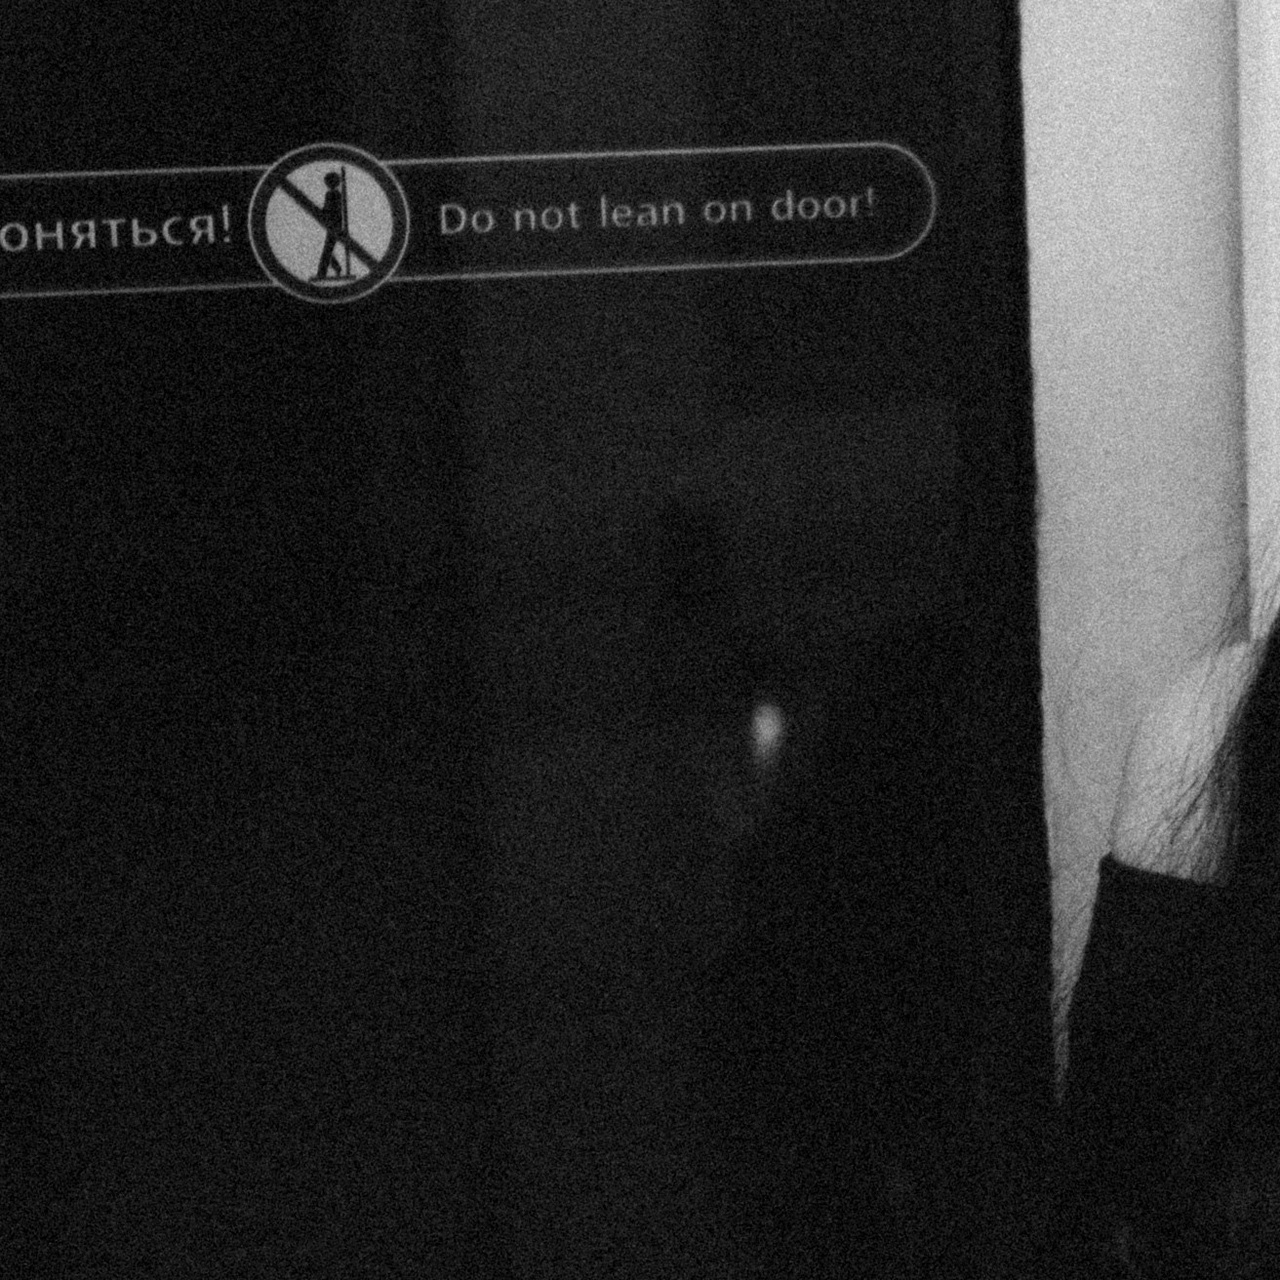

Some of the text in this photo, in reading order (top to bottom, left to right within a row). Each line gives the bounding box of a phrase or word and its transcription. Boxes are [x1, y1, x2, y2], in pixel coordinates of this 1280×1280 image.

[440, 186, 875, 234] Do not lean on door!
